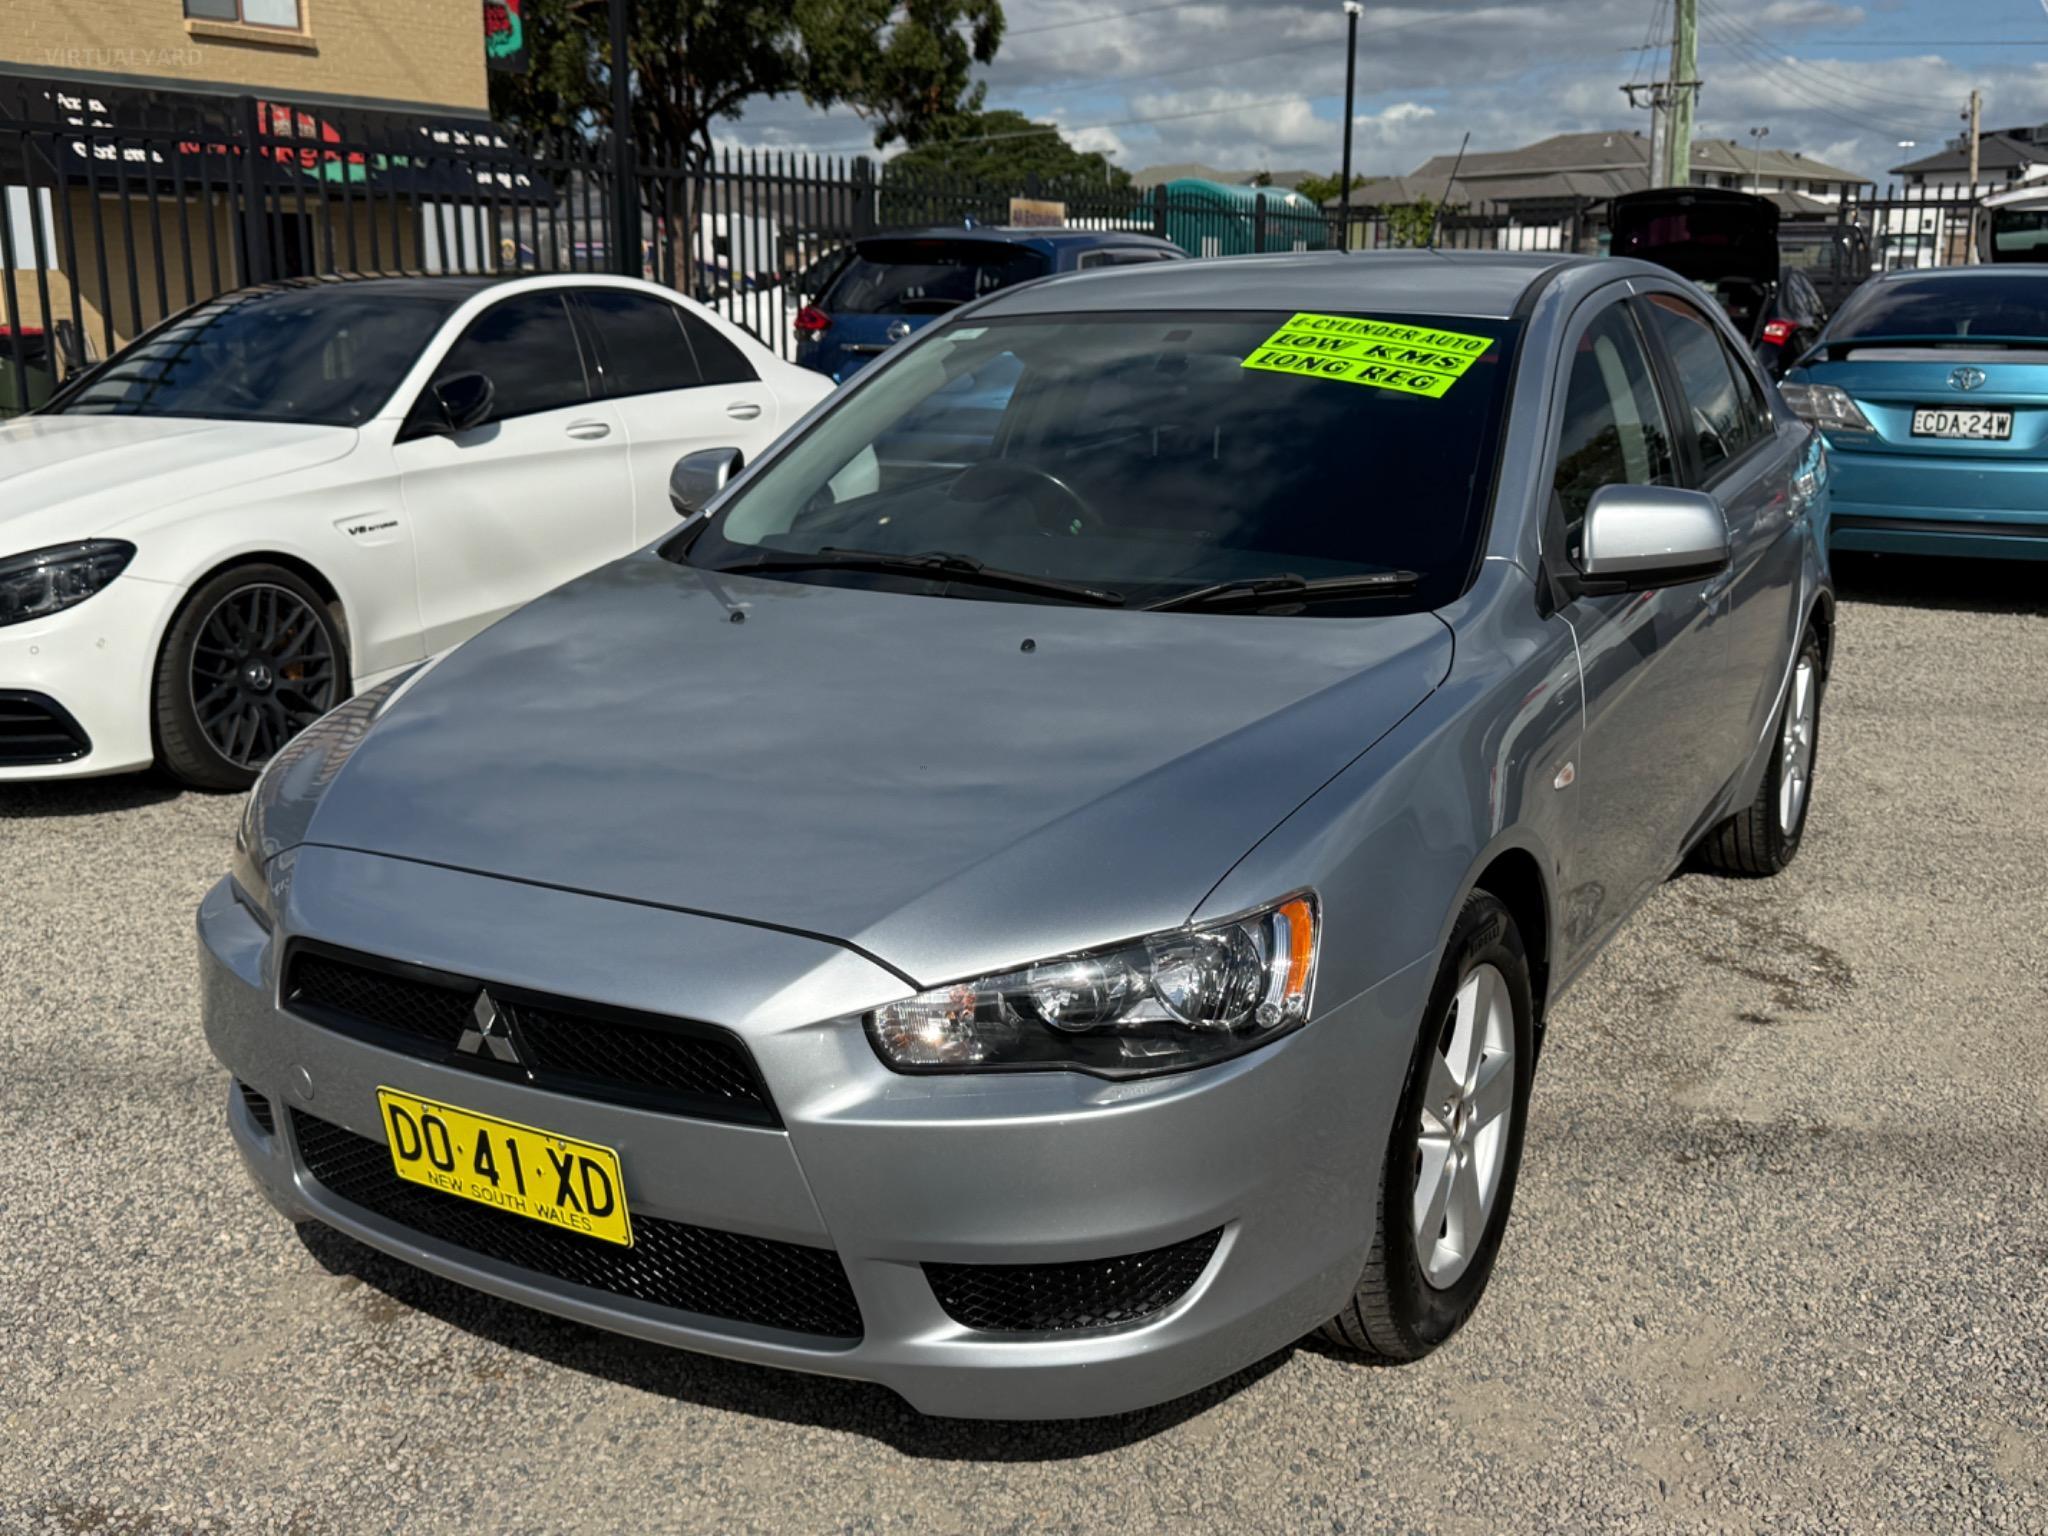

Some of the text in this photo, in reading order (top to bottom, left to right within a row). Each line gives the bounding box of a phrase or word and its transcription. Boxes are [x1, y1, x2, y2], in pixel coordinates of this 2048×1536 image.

[1272, 334, 1465, 370] LOW KMS
[1291, 318, 1484, 351] 4-CYLINDER AUTO
[1255, 352, 1439, 391] LONG REG
[427, 1170, 593, 1231] NEW SOUTH WALES
